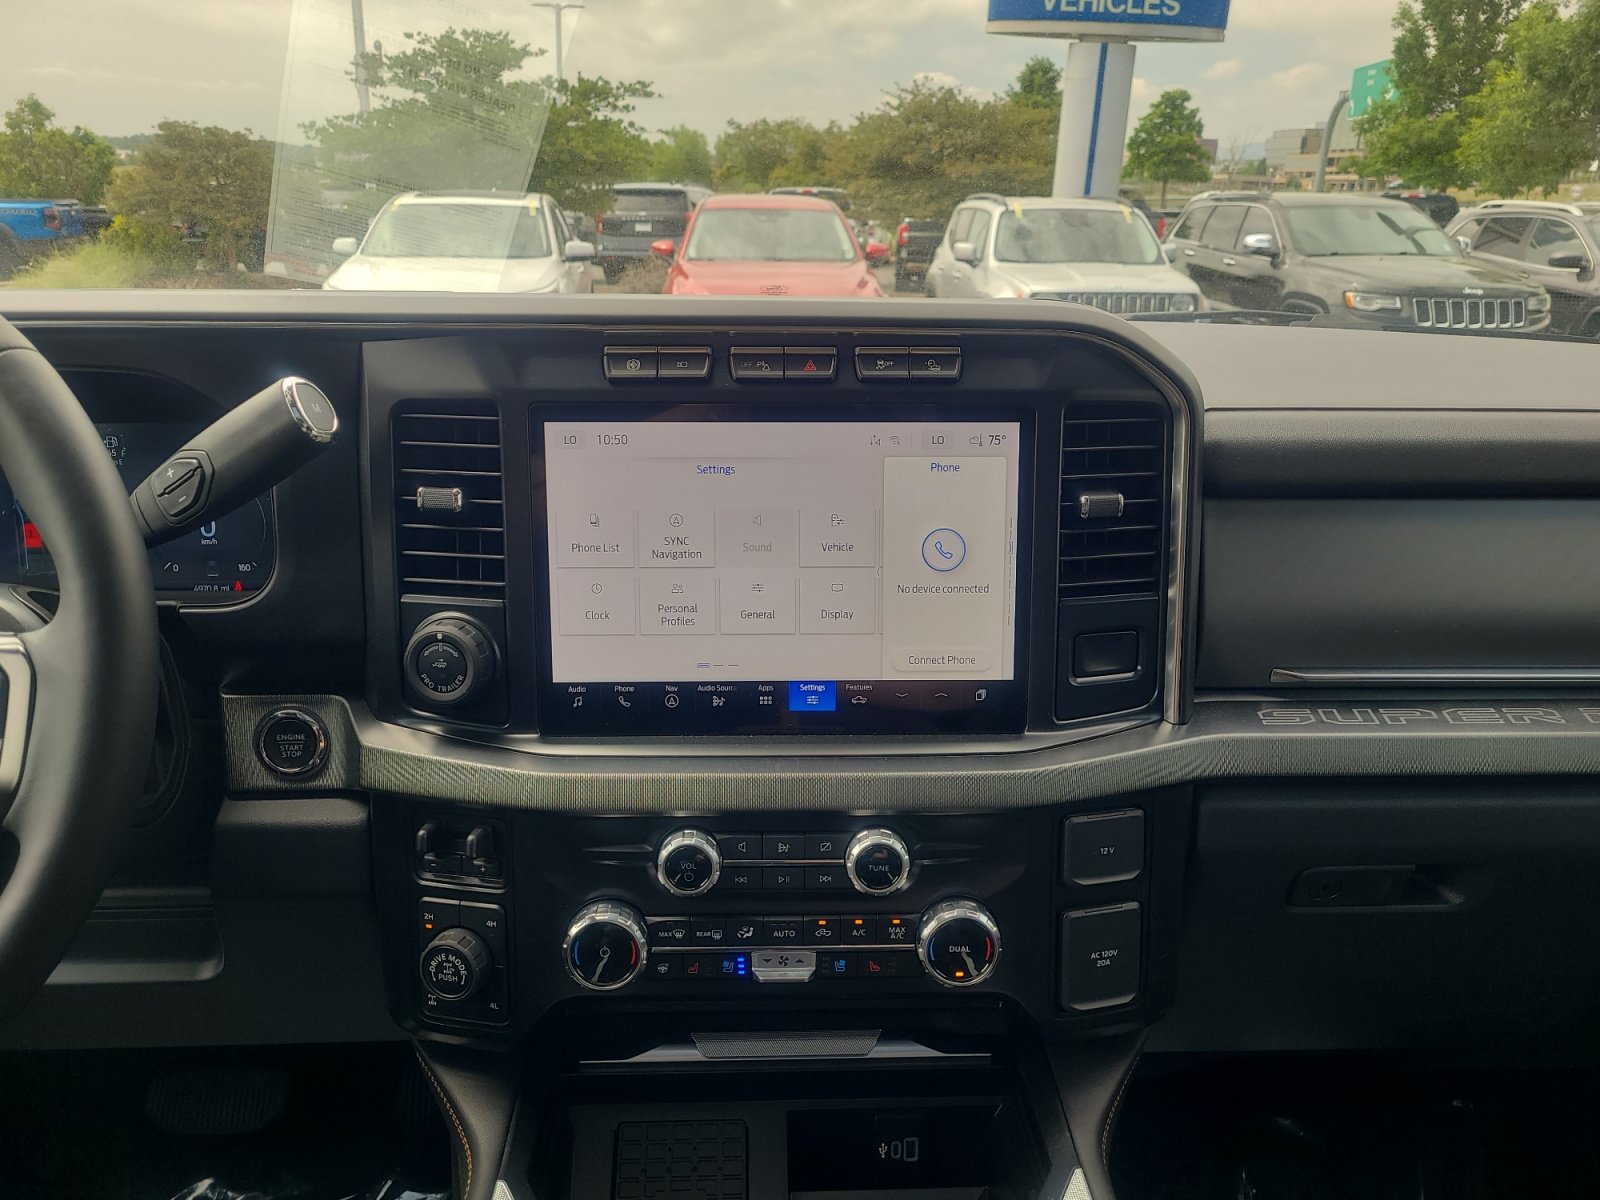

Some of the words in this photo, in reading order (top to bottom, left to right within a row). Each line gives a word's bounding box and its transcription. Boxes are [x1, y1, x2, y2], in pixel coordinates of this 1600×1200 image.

[1043, 0, 1181, 16] VEHICLES
[564, 435, 577, 445] LO
[597, 434, 628, 446] 10:50
[931, 435, 945, 445] LO
[988, 434, 1007, 446] 75°
[697, 464, 736, 476] Settings
[930, 462, 960, 473] Phone
[664, 536, 690, 547] SYNC
[743, 541, 773, 553] Sound
[821, 541, 855, 553] Vehicle
[571, 542, 601, 554] Phone
[603, 542, 620, 554] List
[652, 548, 703, 561] Navigation
[897, 583, 910, 594] No
[912, 583, 940, 594] device
[942, 583, 990, 594] connected
[657, 602, 698, 614] Personal
[585, 609, 610, 621] Clock
[740, 608, 776, 620] General
[820, 608, 854, 622] Display
[661, 615, 696, 627] Profiles
[908, 654, 945, 666] Connect
[947, 654, 976, 666] Phone
[420, 673, 435, 689] PRO
[437, 674, 465, 693] TRAILER
[665, 684, 678, 693] Nav
[697, 684, 716, 693] Audio
[757, 683, 774, 694] Apps
[799, 683, 826, 694] Settings
[845, 682, 873, 692] Features
[567, 685, 587, 694] Audio
[614, 684, 635, 694] Phone
[1257, 708, 1566, 725] SUPER
[680, 862, 697, 870] VOL
[868, 864, 890, 872] TUNE
[423, 912, 434, 921] 2H
[485, 920, 497, 928] 4H
[773, 930, 796, 938] AUTO
[851, 928, 867, 937] A/C
[888, 926, 906, 934] MAX
[949, 945, 971, 953] DUAL
[1090, 951, 1101, 959] AC
[1102, 949, 1119, 957] 120V
[428, 953, 446, 972] DRIVE
[448, 954, 468, 976] MODE
[1097, 959, 1111, 967] 20A
[438, 974, 458, 982] PUSH
[489, 1002, 500, 1010] 4L
